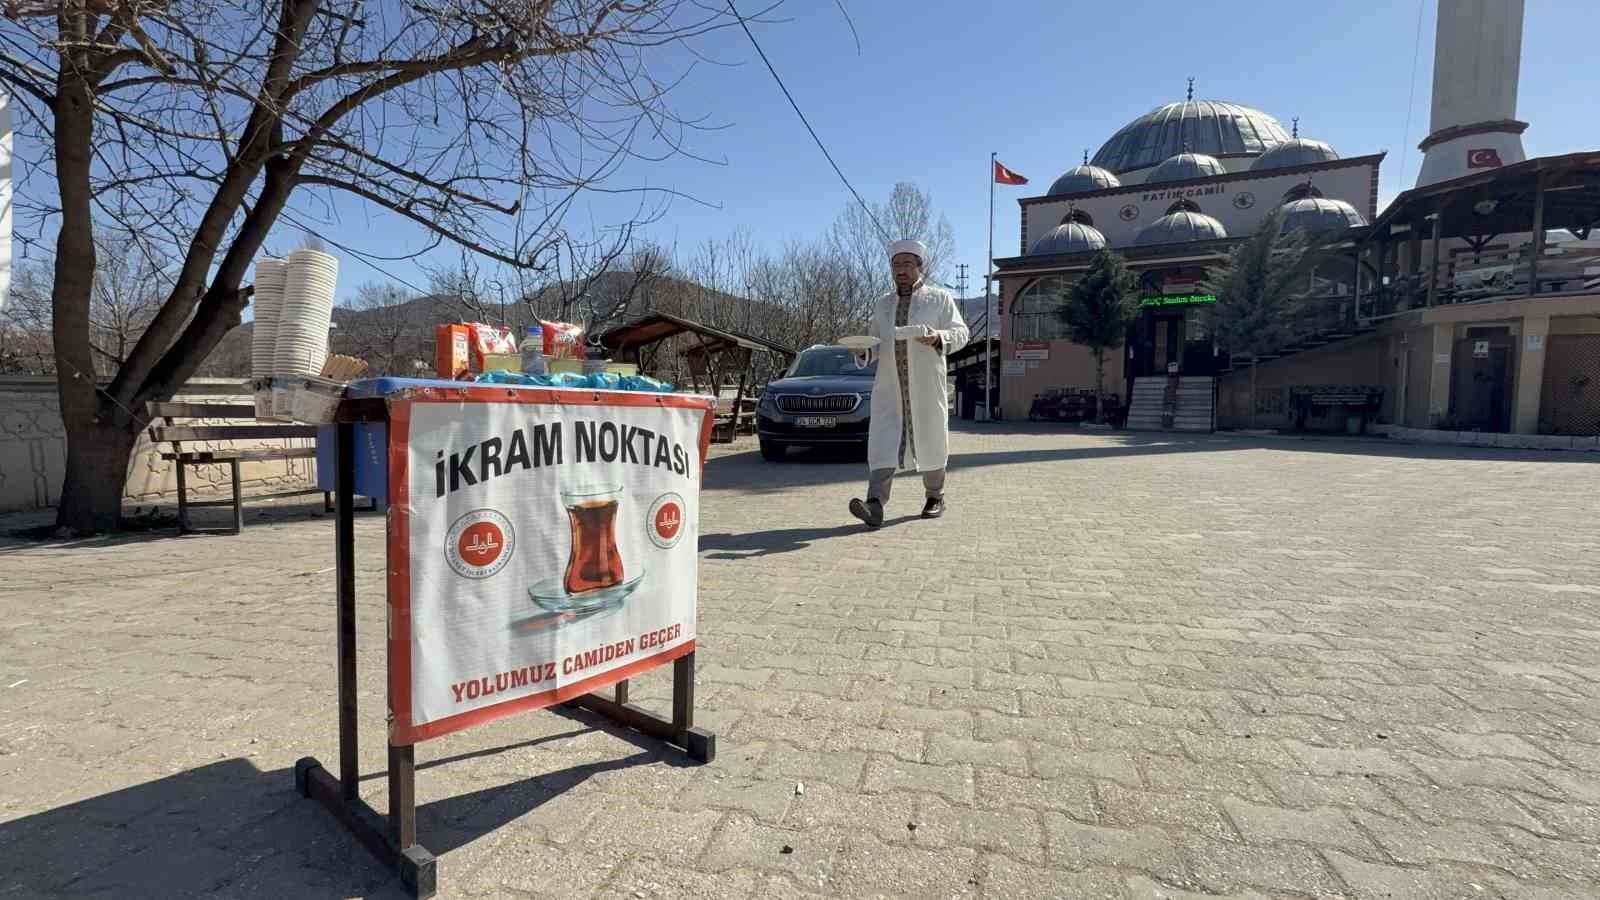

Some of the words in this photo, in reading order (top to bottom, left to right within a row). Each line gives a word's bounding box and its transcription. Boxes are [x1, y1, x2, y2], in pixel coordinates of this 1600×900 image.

[436, 422, 563, 498] İKRAM
[575, 421, 689, 479] NOKTASI
[451, 662, 557, 703] YOLUMUZ
[562, 638, 635, 675] CAMİDEN
[639, 623, 681, 649] GEÇER
